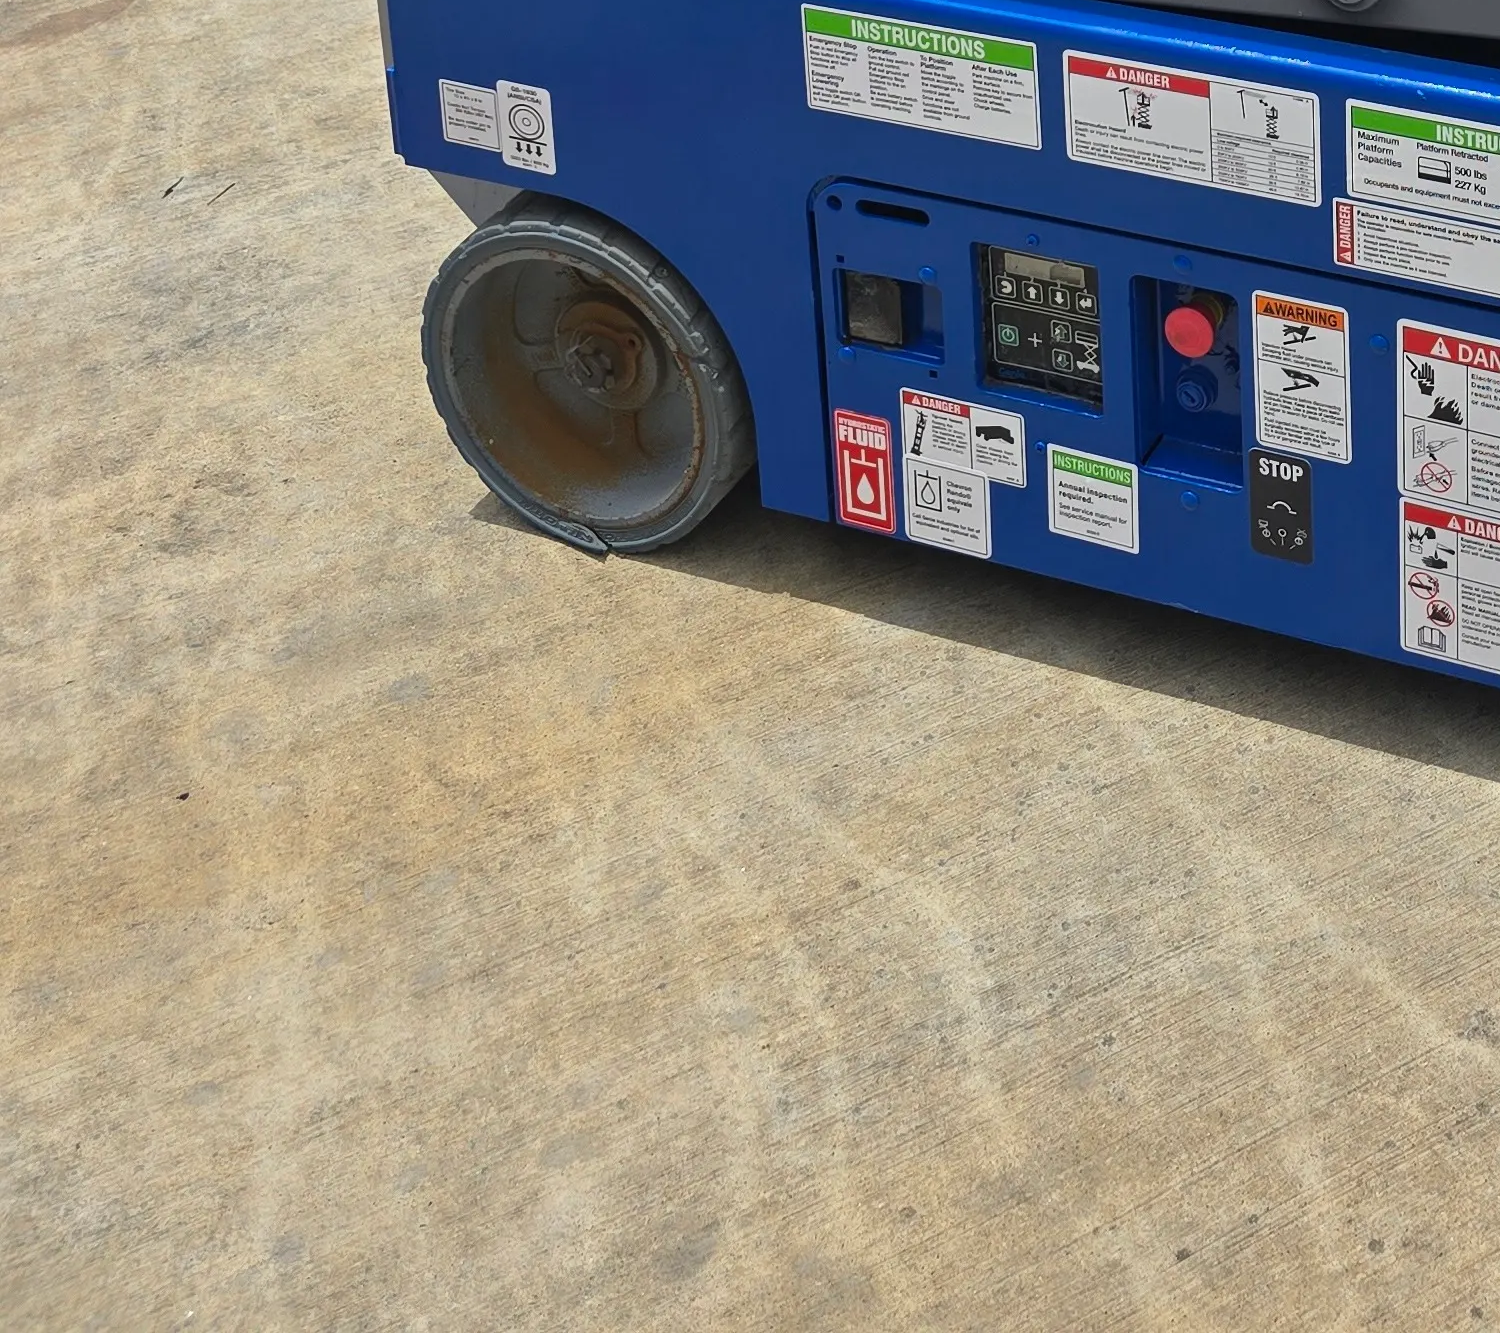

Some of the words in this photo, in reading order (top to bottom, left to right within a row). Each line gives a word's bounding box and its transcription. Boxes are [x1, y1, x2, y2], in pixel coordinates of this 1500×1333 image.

[851, 19, 986, 59] INSTRUCTIONS
[1120, 68, 1170, 88] DANGER
[1358, 131, 1399, 145] Maximum
[1358, 142, 1393, 155] Platform
[1417, 143, 1449, 155] Platform
[1451, 149, 1488, 162] Retracted
[1358, 153, 1402, 168] Capacities
[1455, 167, 1471, 177] 500
[1474, 167, 1487, 180] lbs
[1364, 178, 1399, 190] Occupants
[1401, 183, 1413, 193] and
[1415, 188, 1450, 200] equipment
[1452, 195, 1469, 204] must
[1455, 180, 1471, 190] 227
[1474, 184, 1486, 195] Kg
[1339, 204, 1351, 249] DANGER
[1357, 210, 1379, 220] Failure
[1409, 222, 1446, 233] understand
[1274, 303, 1337, 327] WARNING
[1471, 382, 1492, 391] Death
[1471, 392, 1492, 400] result
[922, 397, 961, 414] DANGER
[839, 425, 886, 450] FLUID
[1471, 439, 1499, 450] Connect
[1055, 454, 1130, 483] INSTRUCTIONS
[1259, 458, 1303, 482] STOP
[1059, 481, 1085, 493] Annual
[1087, 488, 1127, 503] inspection
[1059, 491, 1093, 504] required.
[1059, 502, 1070, 510] See
[1072, 506, 1093, 516] service
[1095, 513, 1117, 522] manual
